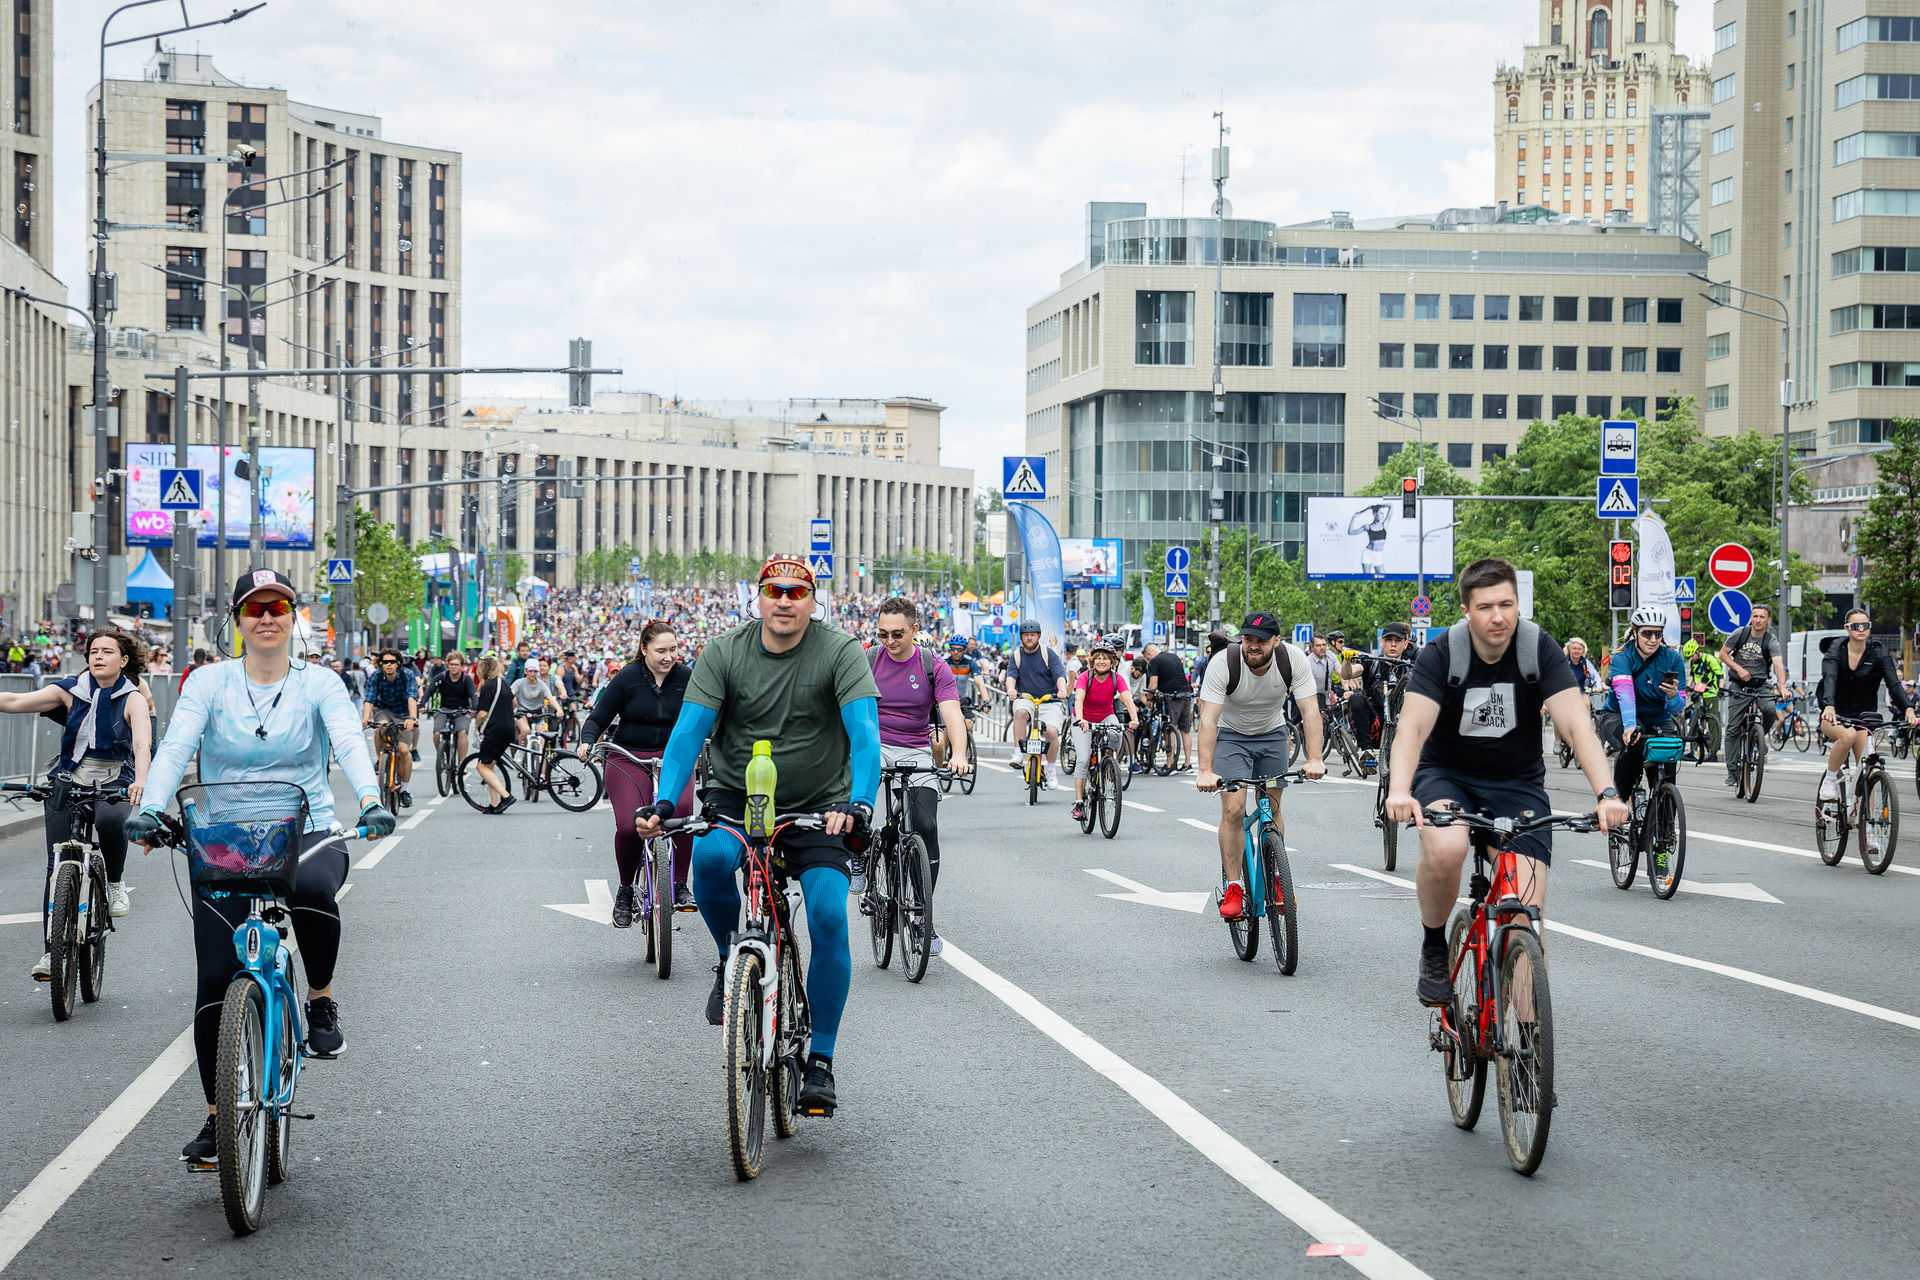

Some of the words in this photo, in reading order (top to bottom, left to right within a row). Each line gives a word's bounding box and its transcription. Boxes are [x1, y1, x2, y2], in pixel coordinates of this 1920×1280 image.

[135, 511, 165, 530] wb
[1613, 565, 1631, 585] 02
[1175, 614, 1186, 627] 02
